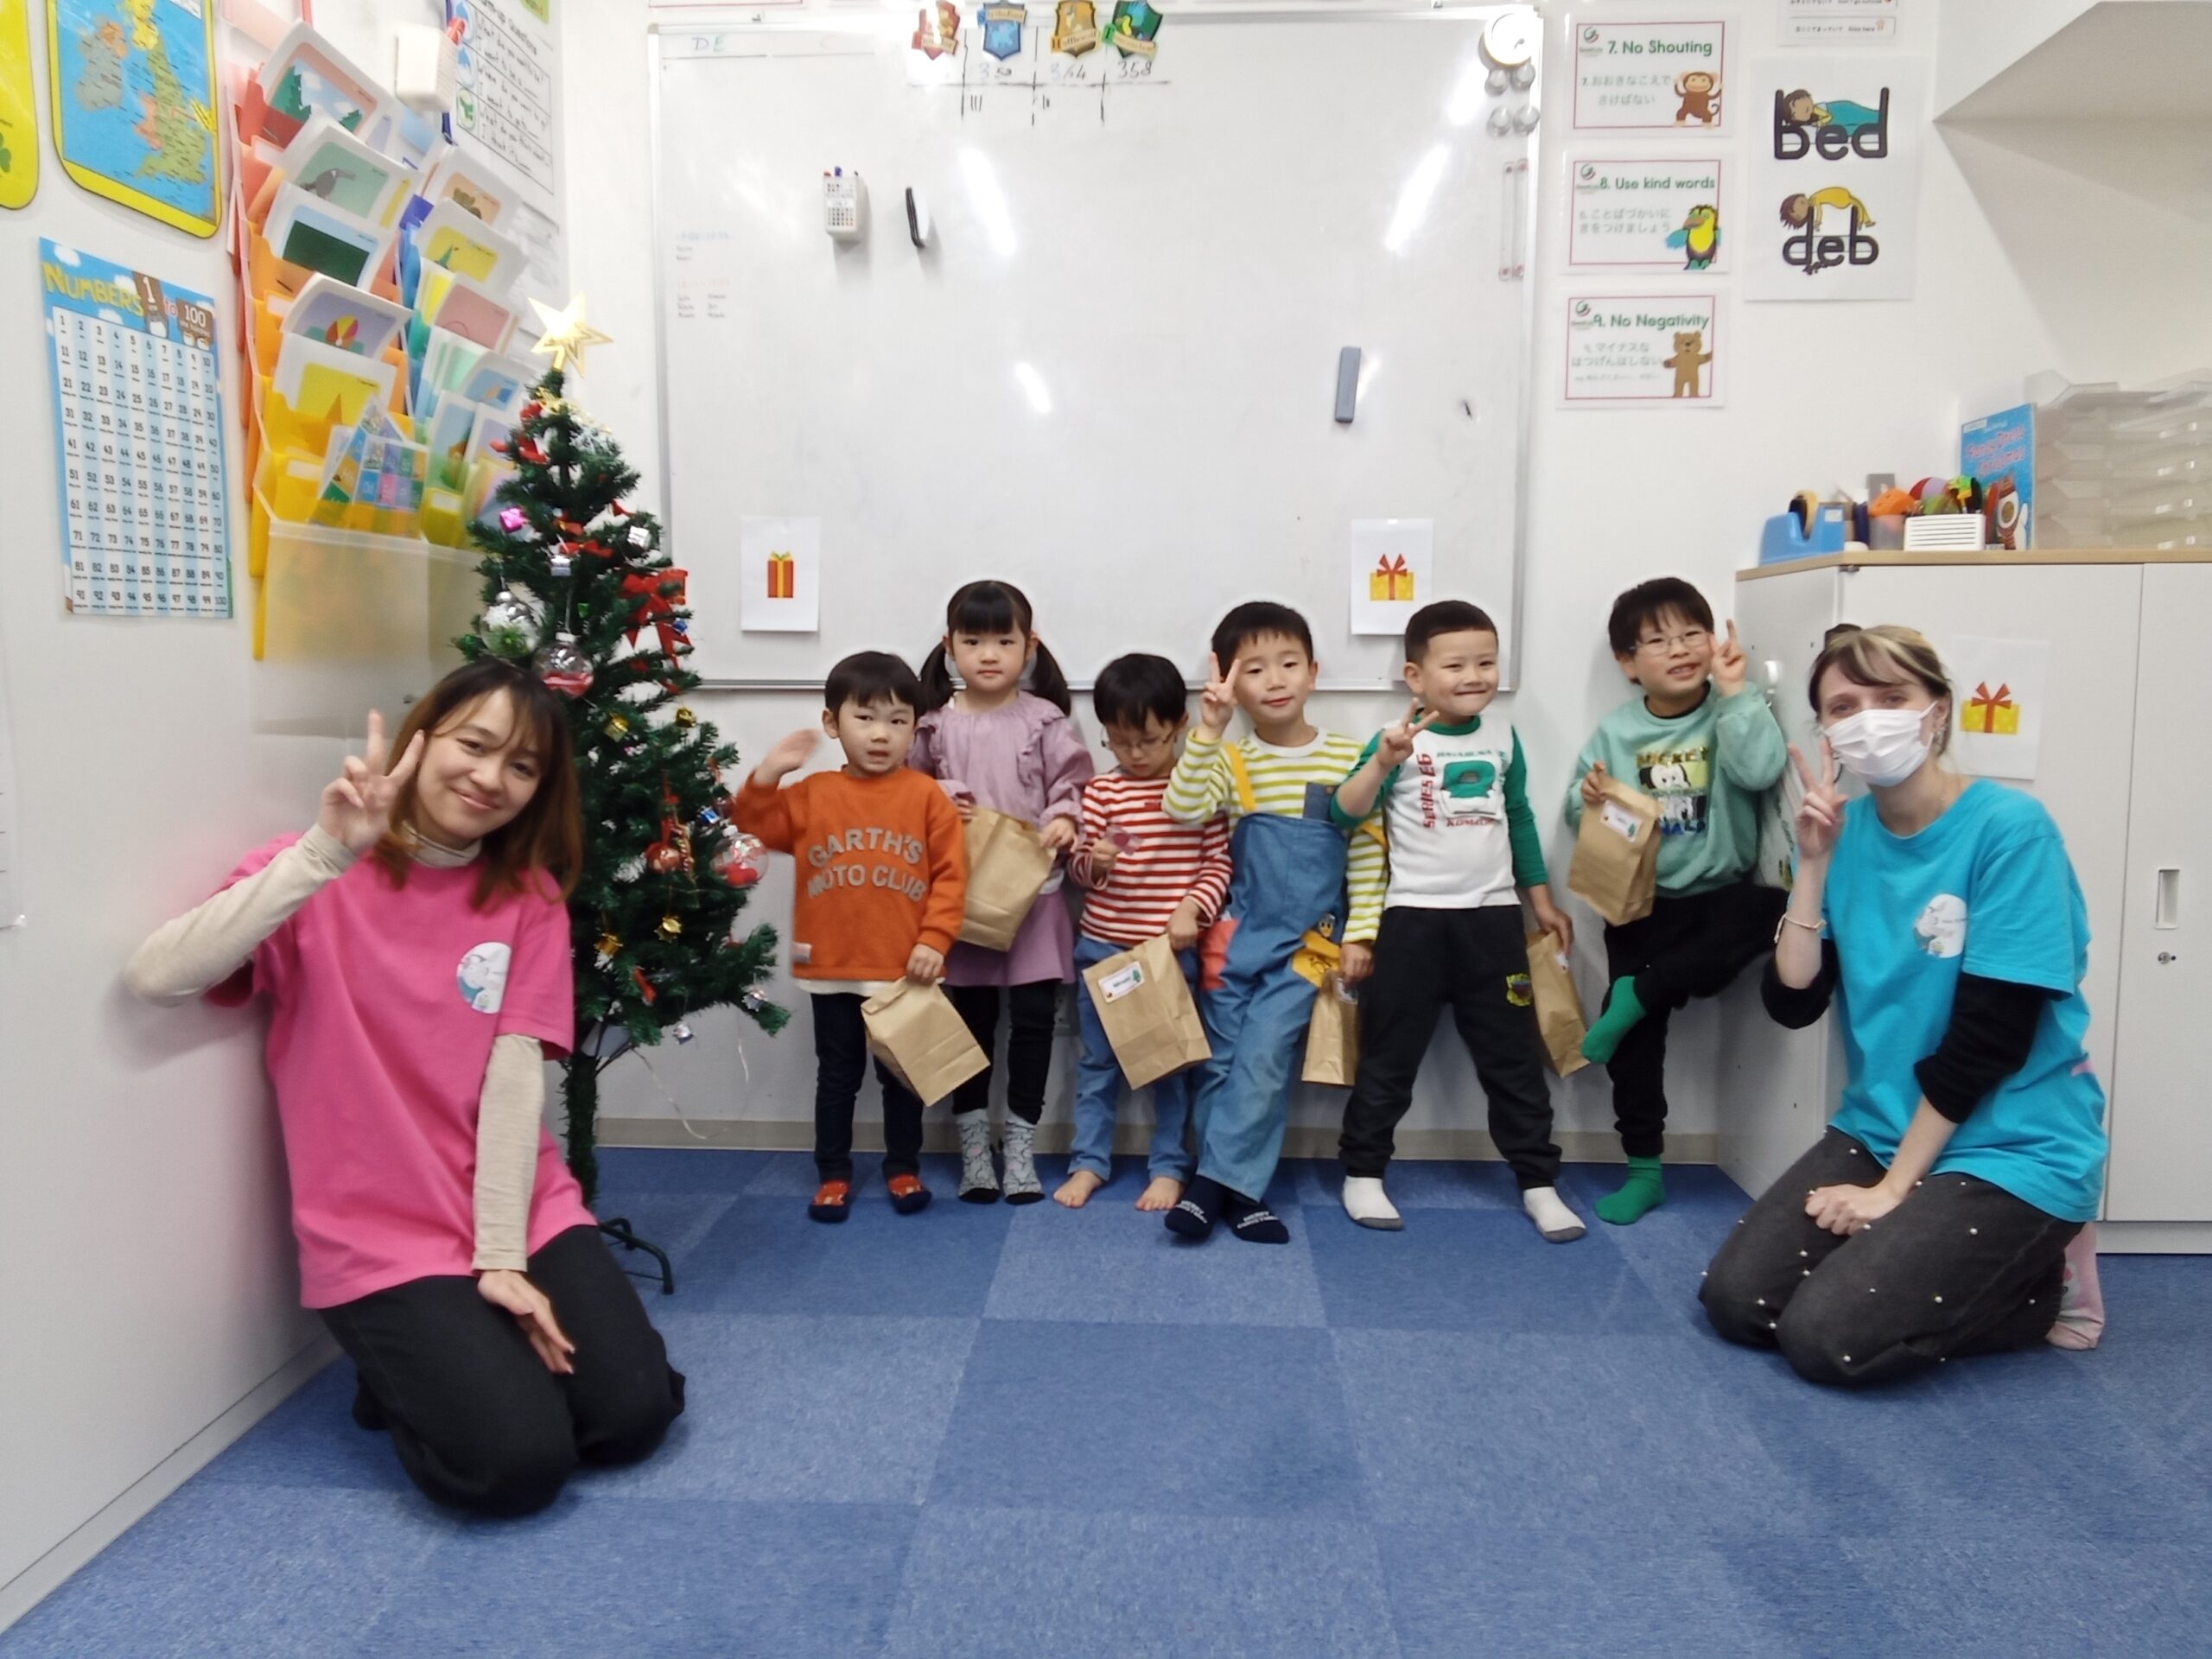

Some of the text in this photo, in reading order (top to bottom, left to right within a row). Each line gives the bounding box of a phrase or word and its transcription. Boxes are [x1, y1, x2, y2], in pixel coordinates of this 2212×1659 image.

[1608, 41, 1618, 54] 7.
[1623, 41, 1643, 54] No
[1649, 40, 1713, 57] Shouting
[1599, 94, 1656, 106] さけばない
[1774, 87, 1890, 161] bed
[1600, 176, 1611, 190] 8.
[1616, 177, 1639, 190] Use
[1643, 176, 1671, 189] kind
[1675, 176, 1715, 189] words
[1783, 205, 1879, 266] deb
[41, 262, 207, 328] NUMBERS 1 to 100
[60, 315, 65, 326] 1
[78, 321, 84, 331] 2
[96, 326, 102, 336] 3
[130, 335, 136, 346] 5
[146, 340, 152, 350] 6
[162, 345, 167, 353] 7
[176, 349, 182, 359] 8
[191, 353, 196, 362] 9
[202, 357, 211, 367] 10
[1593, 314, 1605, 327] 9.
[1611, 315, 1631, 327] No
[1636, 314, 1710, 331] Negativity
[60, 346, 213, 394] 11 12 13 14 15 16 17 18 19 20
[62, 377, 215, 422] 21 22 23 24 25 26 27 28 29 30
[65, 407, 218, 448] 31 32 33 34 35 36 37 38 39 40
[67, 438, 77, 449] 41
[86, 442, 95, 452] 42
[104, 445, 112, 455] 43
[120, 448, 130, 458] 44
[137, 451, 146, 461] 45
[152, 454, 162, 464] 46
[182, 460, 191, 469] 48
[210, 464, 219, 474] 50
[69, 468, 220, 501] 51 52 53 54 55 56 57 58 59 60
[70, 499, 222, 527] 61 62 63 64 65 66 67 68 69 70
[73, 530, 223, 554] 71 72 73 74 75 76 77 78 79 80
[75, 561, 224, 581] 81 82 83 84 85 86 87 88 89 90
[76, 589, 226, 606] 91 92 93 94 95 96 97 98 99 100
[1421, 780, 1437, 829] SERIES
[808, 826, 924, 868] GARTH'S
[807, 864, 928, 903] MOTO CLUB
